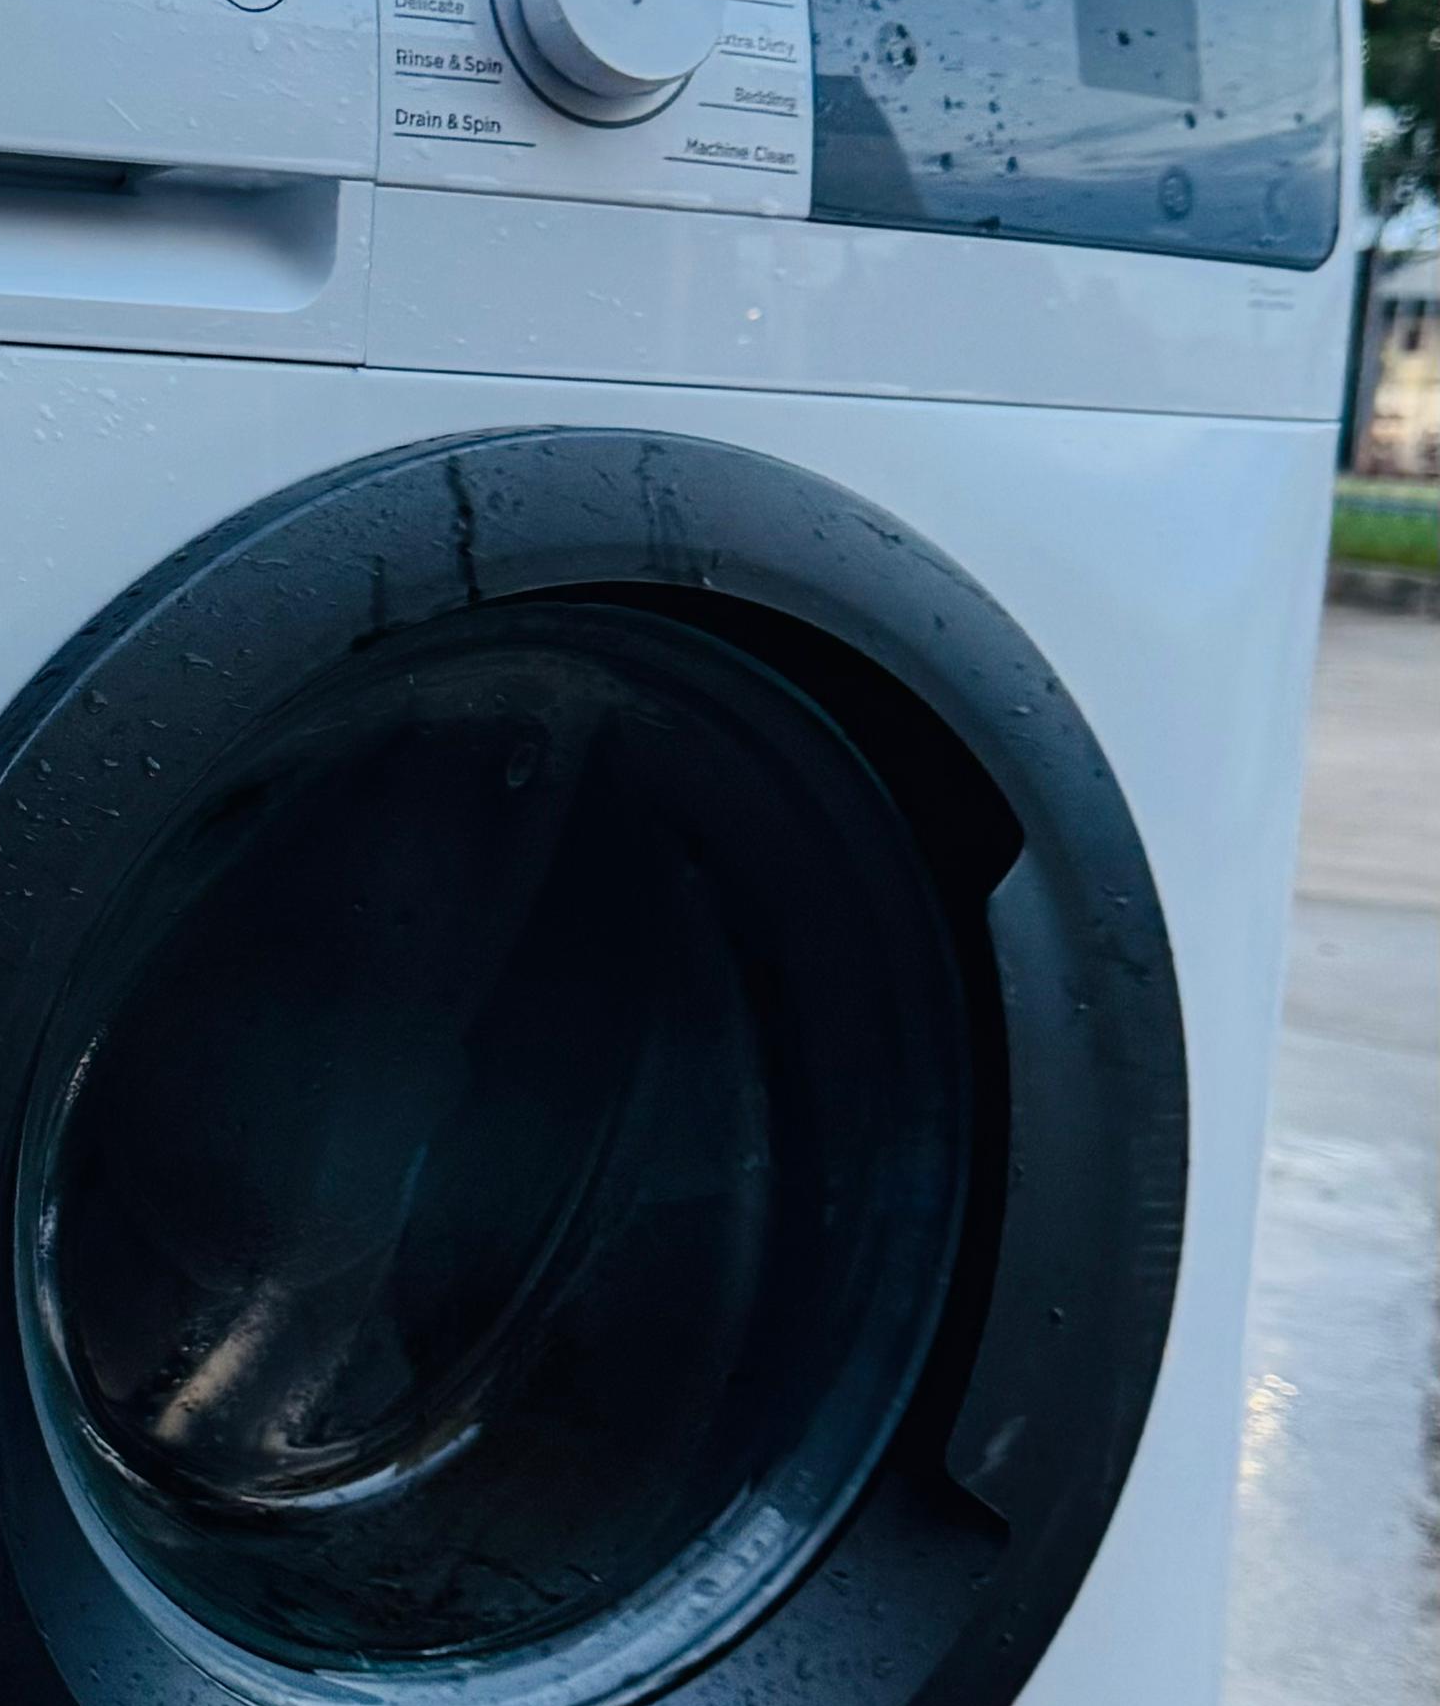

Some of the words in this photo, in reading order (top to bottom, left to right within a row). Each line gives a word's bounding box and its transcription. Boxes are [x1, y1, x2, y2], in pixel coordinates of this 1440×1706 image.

[395, 48, 445, 69] Rinse
[448, 54, 461, 71] &
[463, 55, 504, 76] Spin
[394, 108, 443, 129] Drain
[447, 112, 459, 131] &
[461, 114, 502, 136] Spin
